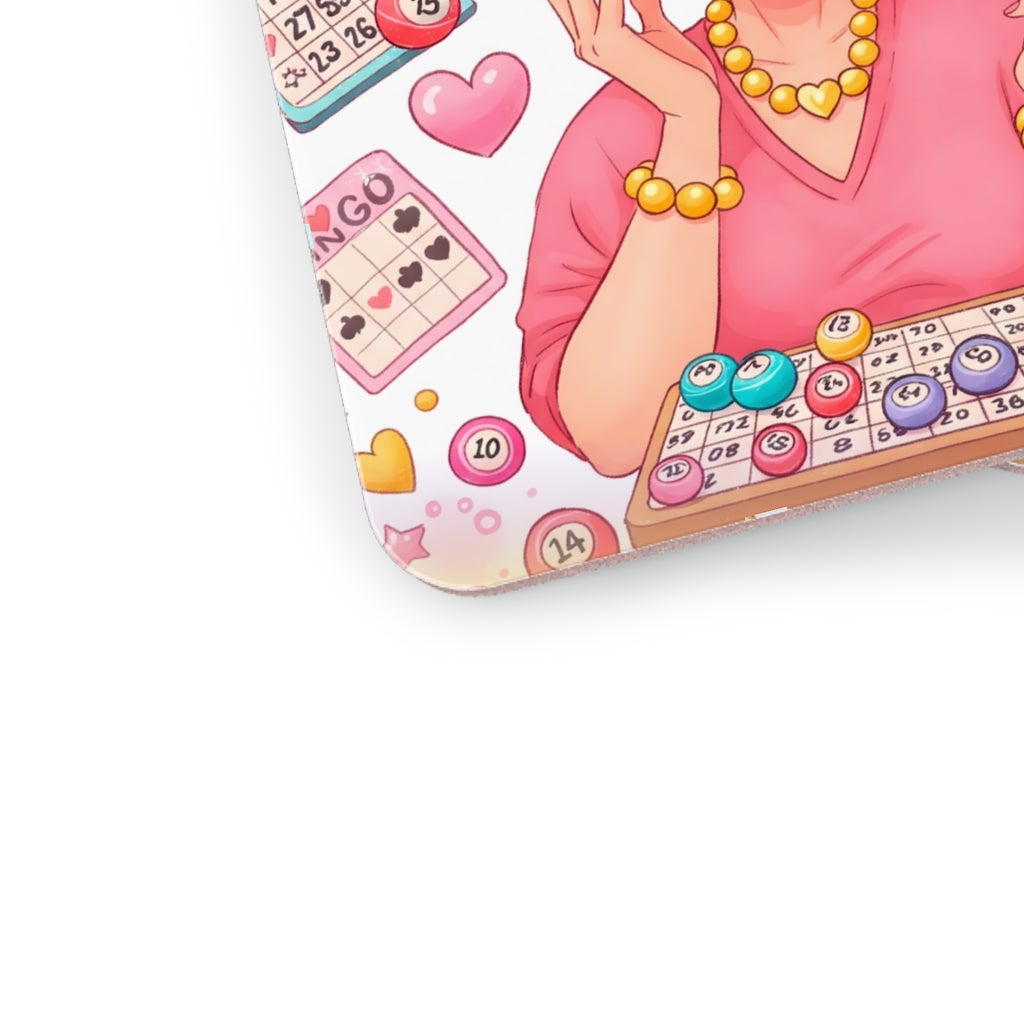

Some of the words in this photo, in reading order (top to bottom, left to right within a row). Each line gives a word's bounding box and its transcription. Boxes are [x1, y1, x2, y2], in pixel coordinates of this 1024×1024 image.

[284, 4, 317, 41] 27
[308, 40, 342, 73] 23
[344, 16, 378, 49] 26
[472, 436, 501, 461] 10
[548, 529, 586, 565] 14
